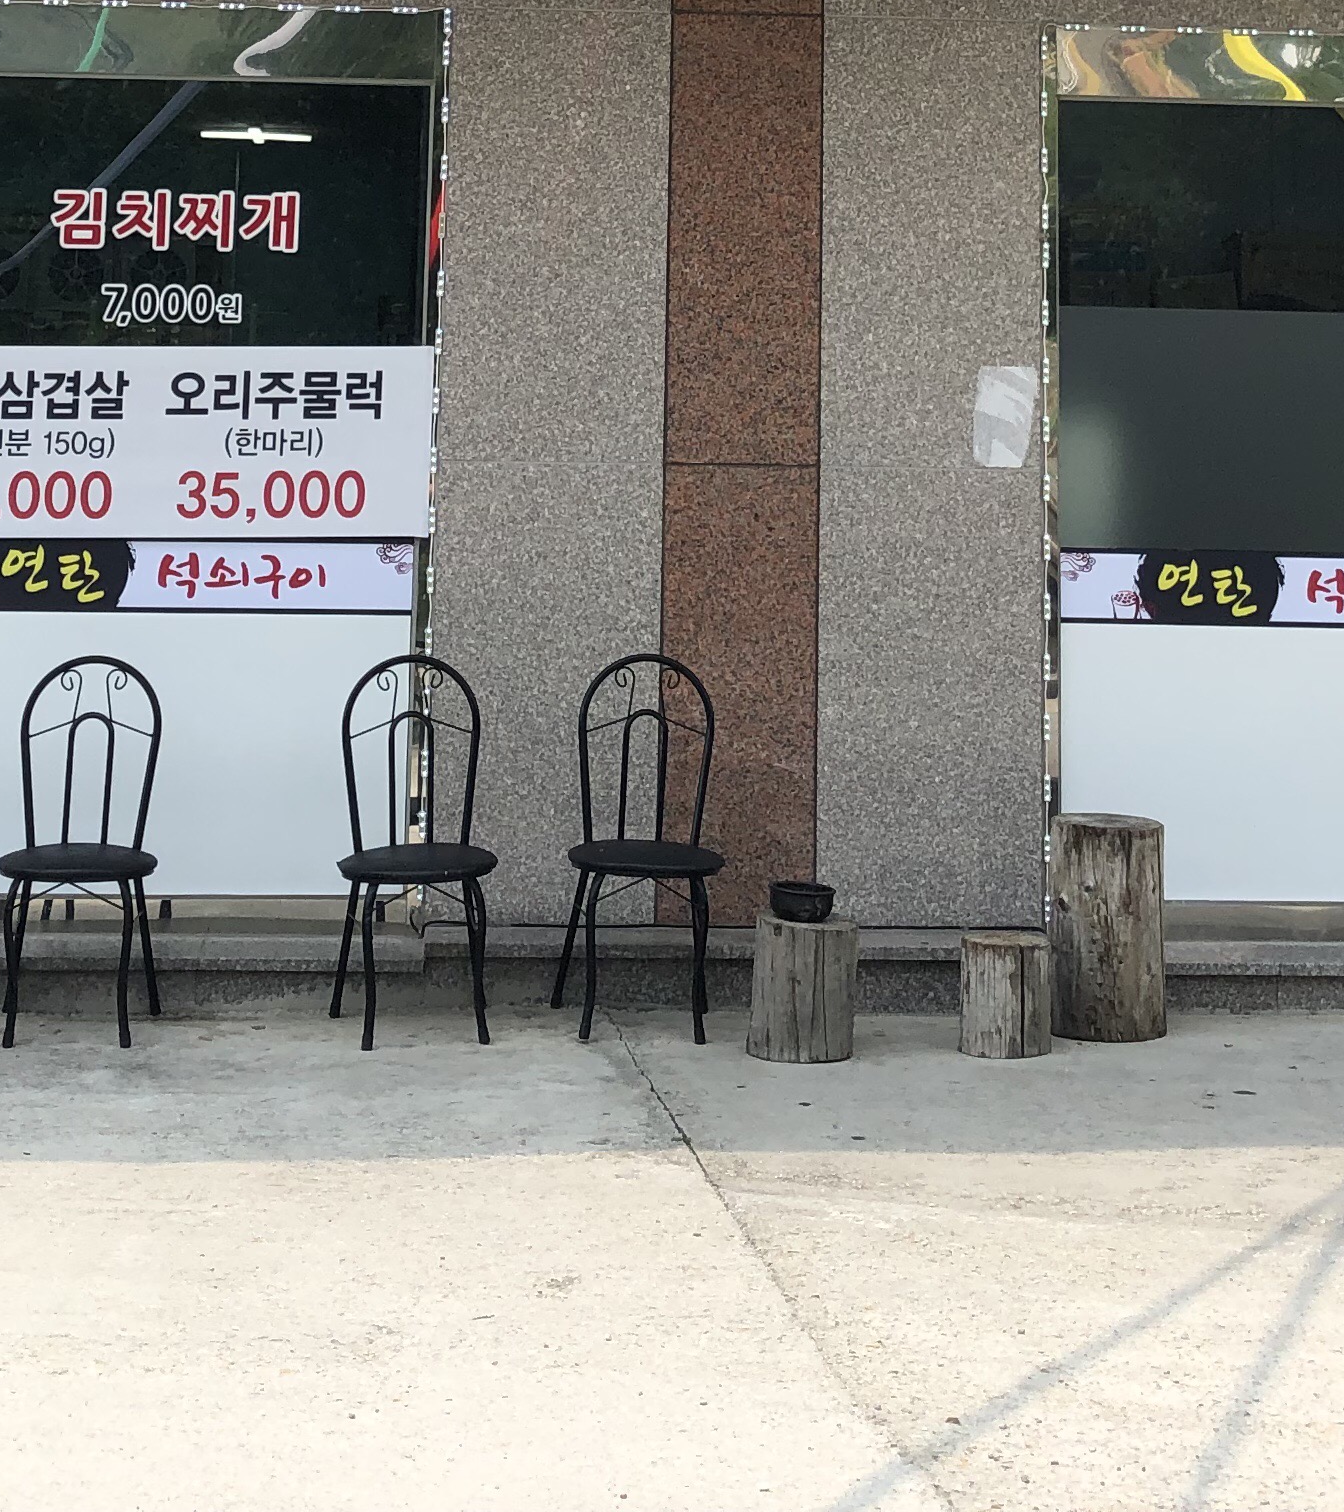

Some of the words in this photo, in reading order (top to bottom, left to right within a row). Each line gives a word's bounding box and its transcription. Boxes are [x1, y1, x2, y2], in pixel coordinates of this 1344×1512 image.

[52, 188, 301, 253] 김치찌개
[164, 369, 384, 421] 오리주물럭
[42, 426, 116, 460] 150g)
[223, 425, 325, 460] (한마리)
[175, 468, 367, 522] 35,000
[0, 545, 105, 604] 연탄
[156, 551, 328, 600] 석쇠구이
[1157, 559, 1258, 618] 연탄
